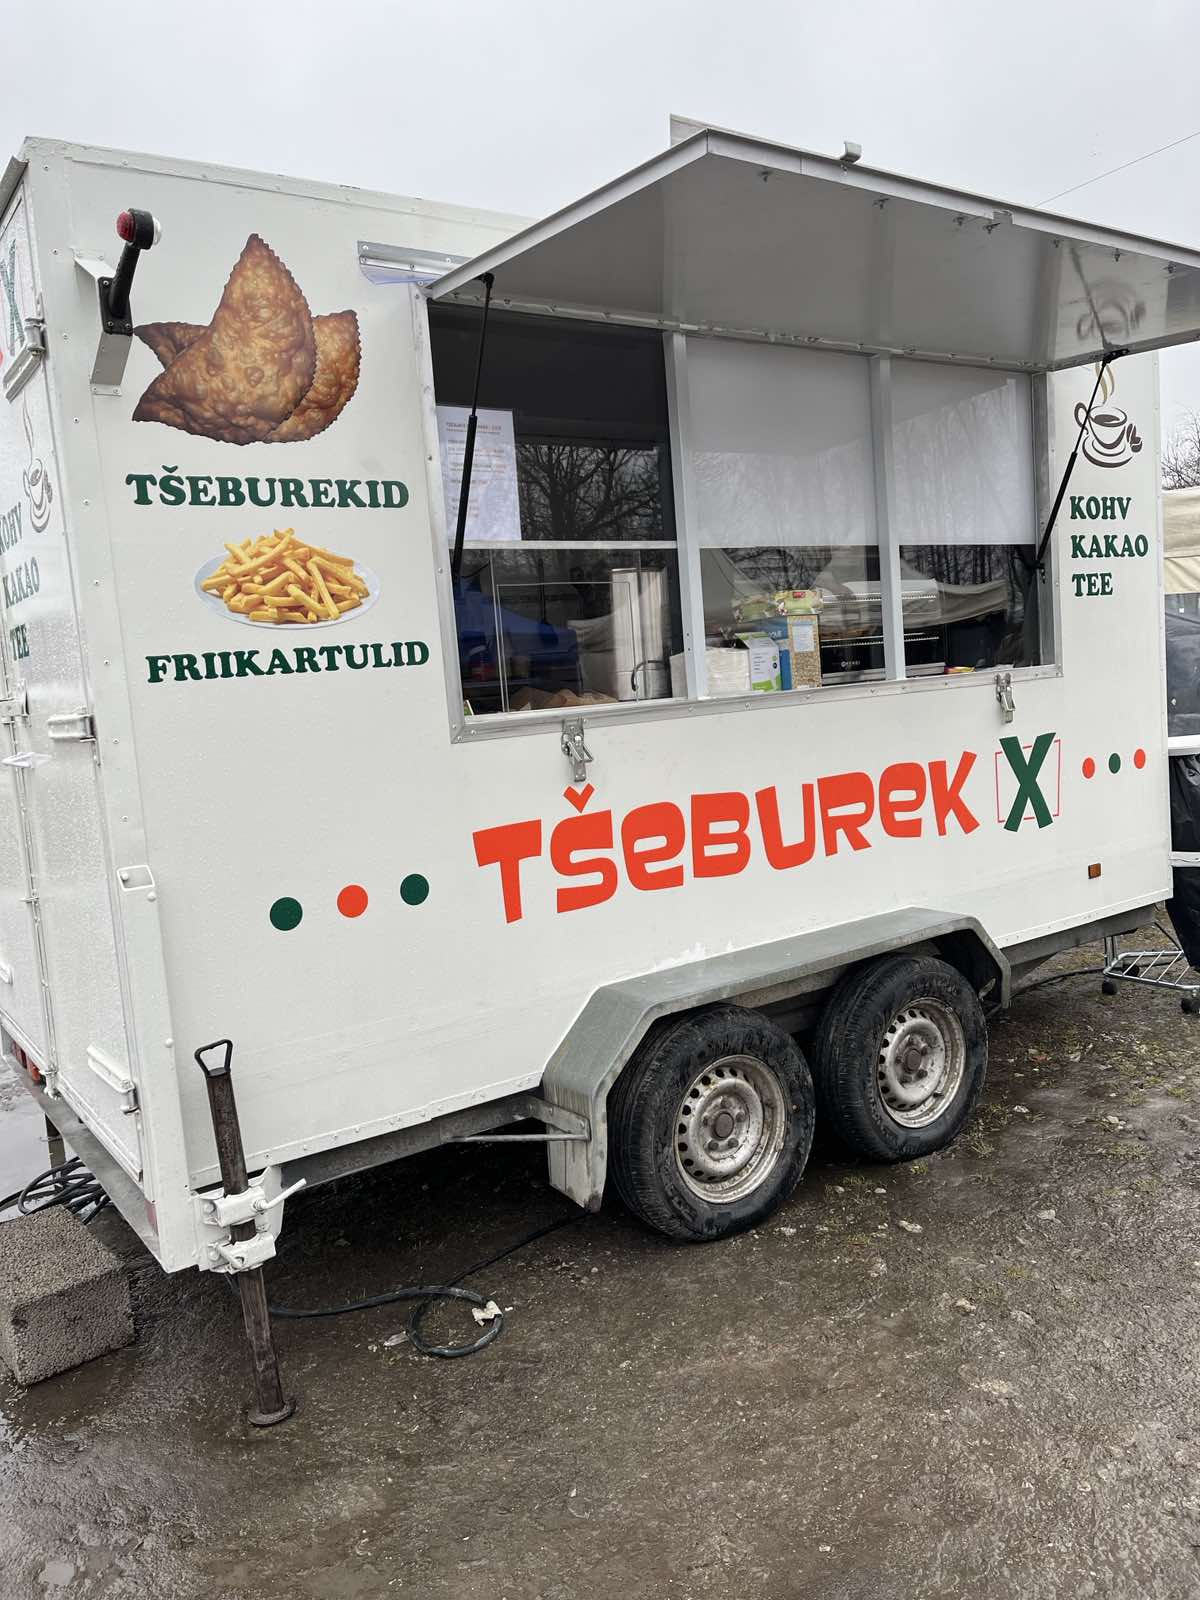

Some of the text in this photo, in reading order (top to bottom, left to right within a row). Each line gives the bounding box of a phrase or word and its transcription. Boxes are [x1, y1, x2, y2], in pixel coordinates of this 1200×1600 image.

[125, 465, 409, 509] TŠEBUREKID
[1070, 495, 1131, 520] KOHV
[1070, 534, 1149, 559] KAKAO
[3, 556, 40, 609] KAKAO
[1072, 572, 1113, 597] TEE
[9, 623, 30, 661] TEE
[145, 640, 430, 683] FRIIKARTULID
[998, 732, 1056, 832] X
